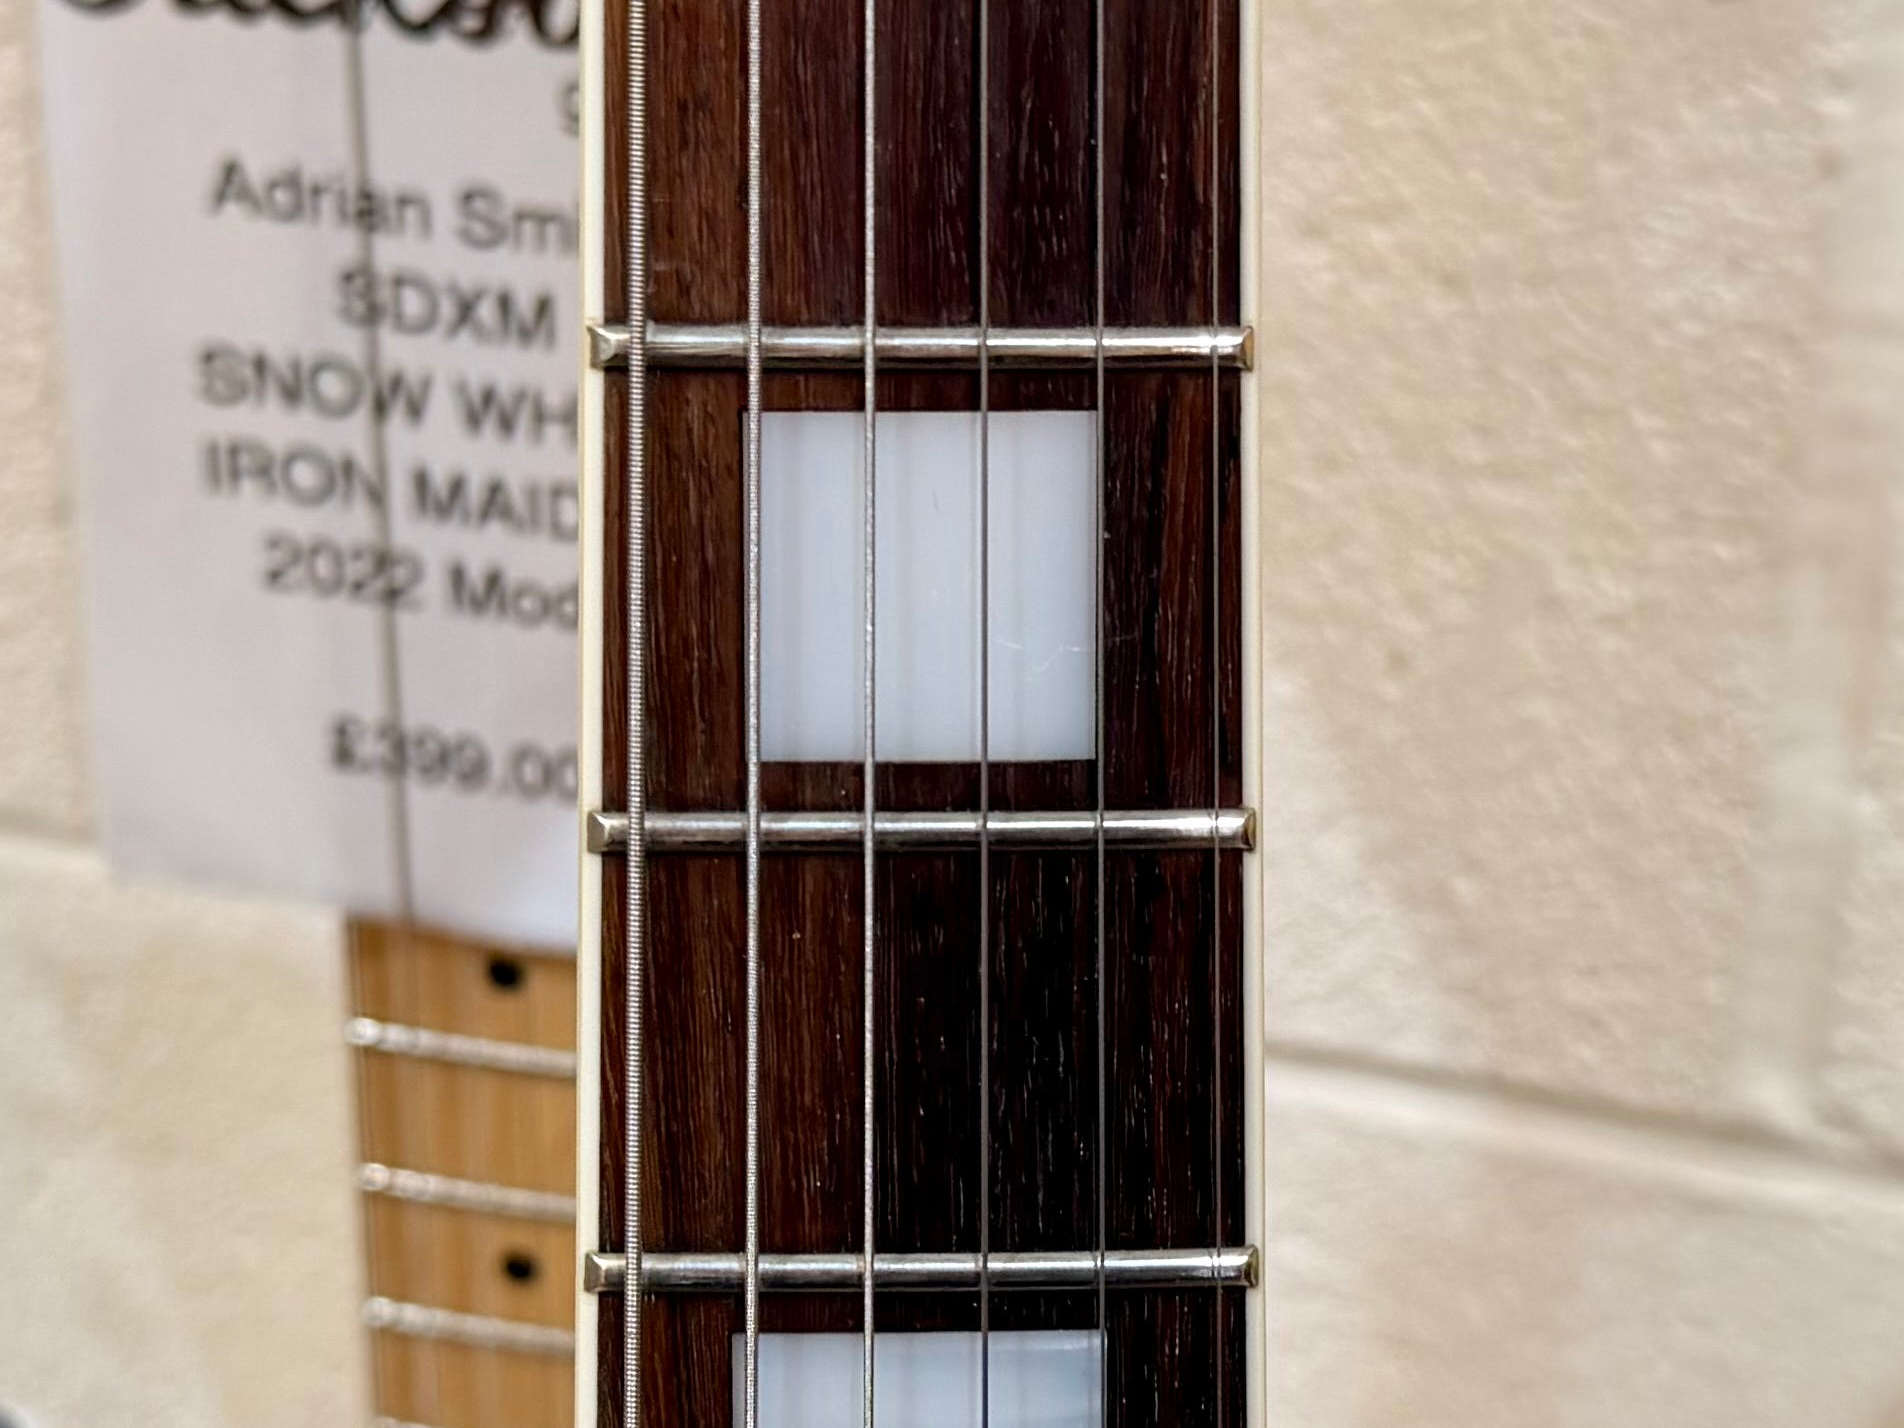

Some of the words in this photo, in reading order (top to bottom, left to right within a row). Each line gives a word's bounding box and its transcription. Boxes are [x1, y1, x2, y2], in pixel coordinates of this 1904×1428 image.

[208, 155, 434, 240] Adrian
[336, 264, 558, 356] SDXM
[198, 340, 434, 428] SNOW
[203, 435, 386, 512] IRON
[259, 530, 426, 609] 2022
